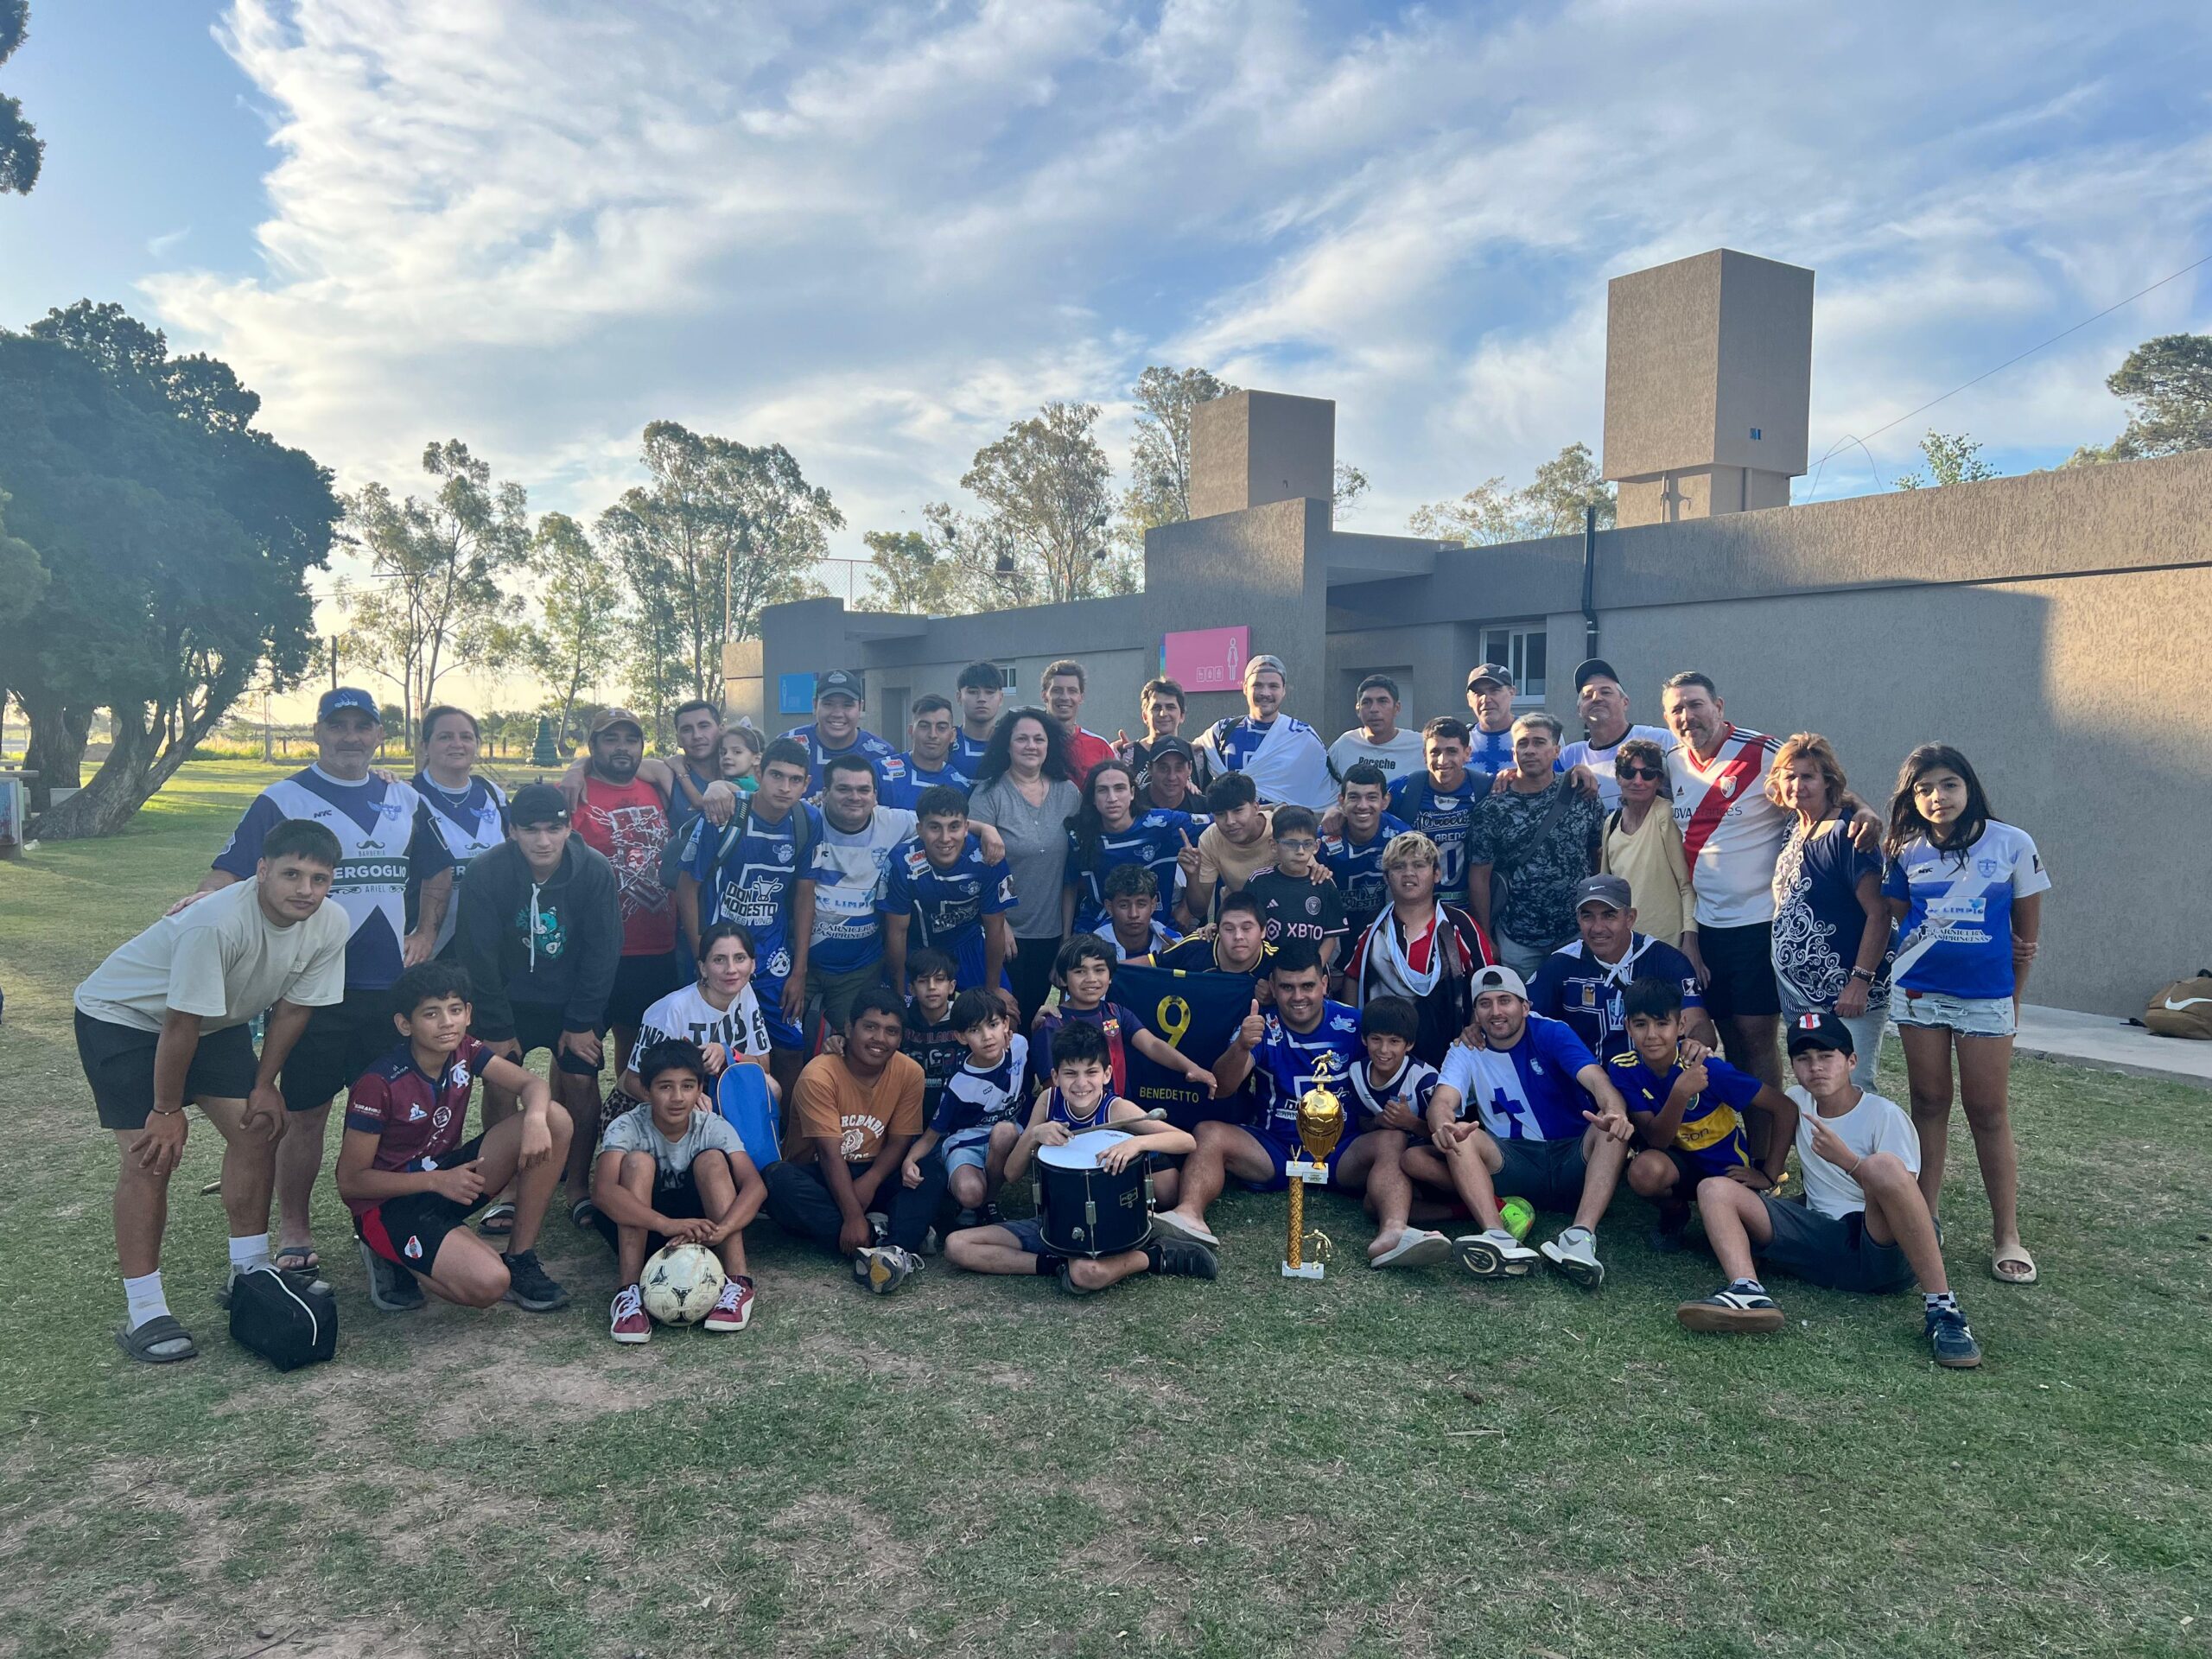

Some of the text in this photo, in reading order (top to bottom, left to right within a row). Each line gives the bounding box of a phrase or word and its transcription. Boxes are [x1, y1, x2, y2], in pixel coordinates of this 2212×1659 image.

[313, 809, 333, 819] NYC
[334, 864, 407, 880] ERGOGLIO
[365, 884, 386, 893] ARIEL
[721, 893, 778, 917] MODESTO
[1287, 922, 1324, 941] XBTO
[1156, 995, 1192, 1049] 9
[1139, 1086, 1199, 1103] BENEDETTO
